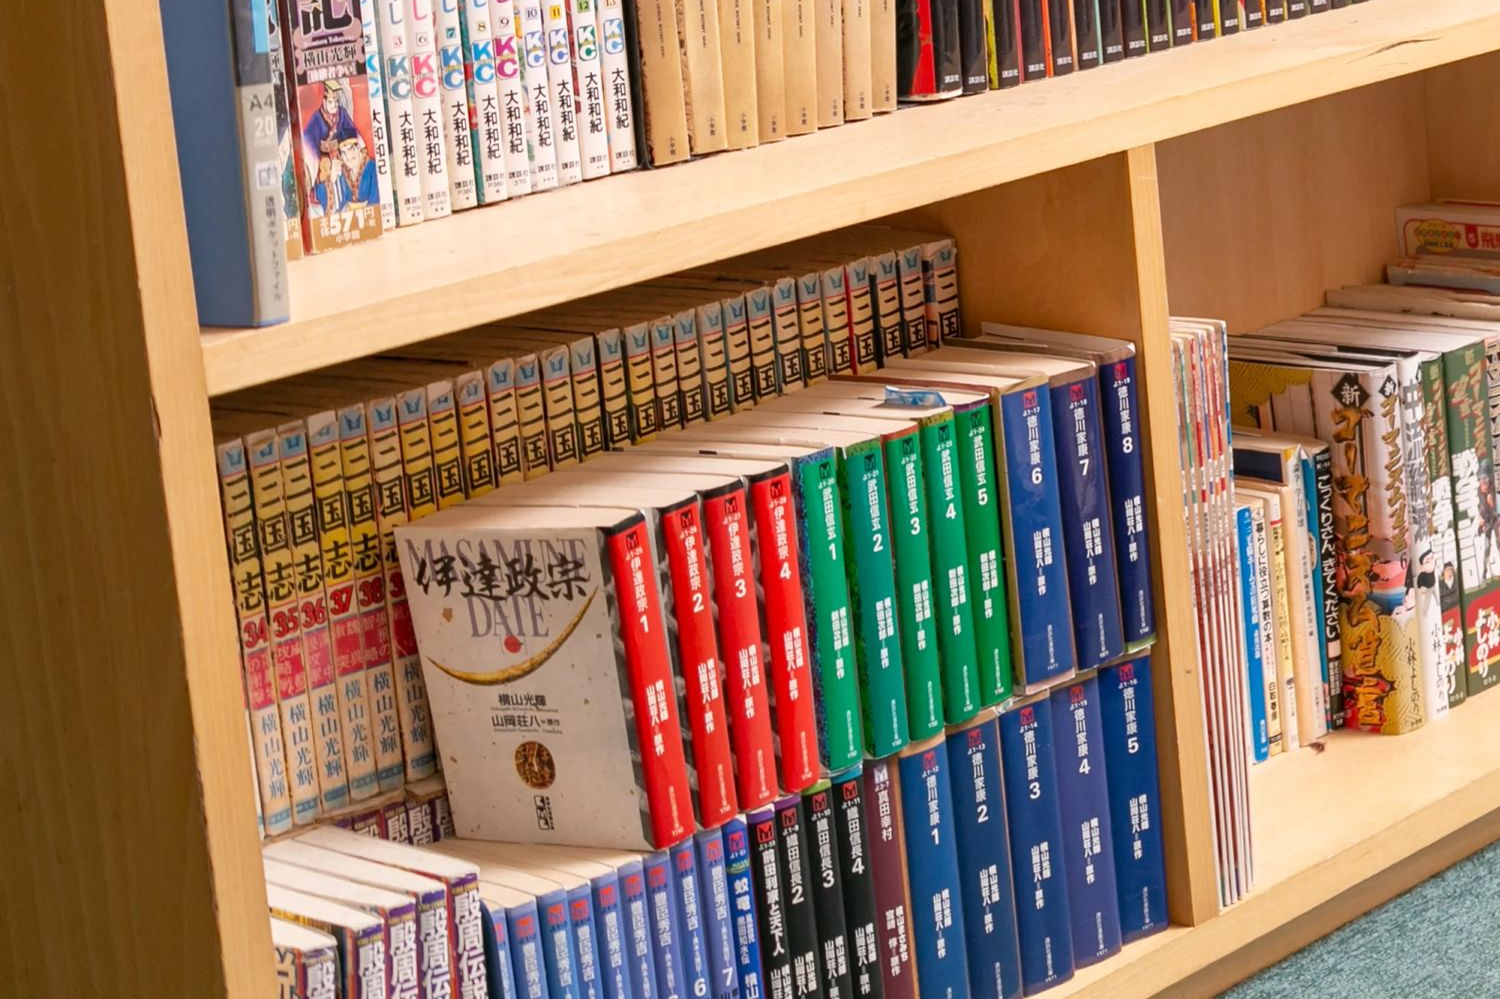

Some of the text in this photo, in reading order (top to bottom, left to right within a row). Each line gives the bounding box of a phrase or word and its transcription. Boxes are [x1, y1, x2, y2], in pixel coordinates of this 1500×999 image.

[250, 94, 274, 112] A4
[254, 117, 274, 137] 20
[505, 90, 523, 154] 大和和紀
[557, 80, 575, 141] 大和和紀
[612, 68, 629, 129] 大和和紀
[423, 108, 441, 174] 大和和紀
[1117, 385, 1133, 453] 徳川家康 8
[1341, 383, 1360, 406] 新
[973, 435, 988, 505] 武田信玄 5
[1027, 414, 1042, 484] 徳川家康 6
[314, 445, 354, 615] 三国志 37
[822, 487, 836, 560] 武田信玄 1
[867, 479, 883, 552] 武田信玄 2
[906, 462, 920, 535] 武田信玄 3
[258, 466, 299, 638] 三国志 35
[417, 553, 589, 601] 伊達政宗
[684, 535, 704, 613] 伊達政宗 2
[728, 522, 746, 597] 伊達政宗 3
[774, 506, 791, 579] 伊達政宗 4
[1318, 476, 1340, 638] こっくりさん、きてください
[284, 458, 343, 778] 三国志 36 横山光輝
[343, 438, 398, 754] 三国志 38 横山光輝
[630, 555, 649, 632] 伊達政宗 1
[1255, 522, 1273, 644] 暮らしに役立つ算数の本
[225, 475, 285, 798] 三国志 34 横山光輝
[498, 694, 547, 706] 横山光輝
[1123, 687, 1138, 753] 徳川家康 5
[972, 751, 989, 823] 徳川家康 2
[1024, 729, 1040, 799] 徳川家康 3
[846, 808, 864, 875] 織田信長 4
[878, 792, 892, 840] 真田幸村
[926, 775, 940, 845] 徳川家康 1
[762, 849, 784, 956] 前田利家と天下人
[786, 834, 804, 904] 織田信長 2
[694, 978, 706, 997] 6
[722, 968, 734, 986] 7
